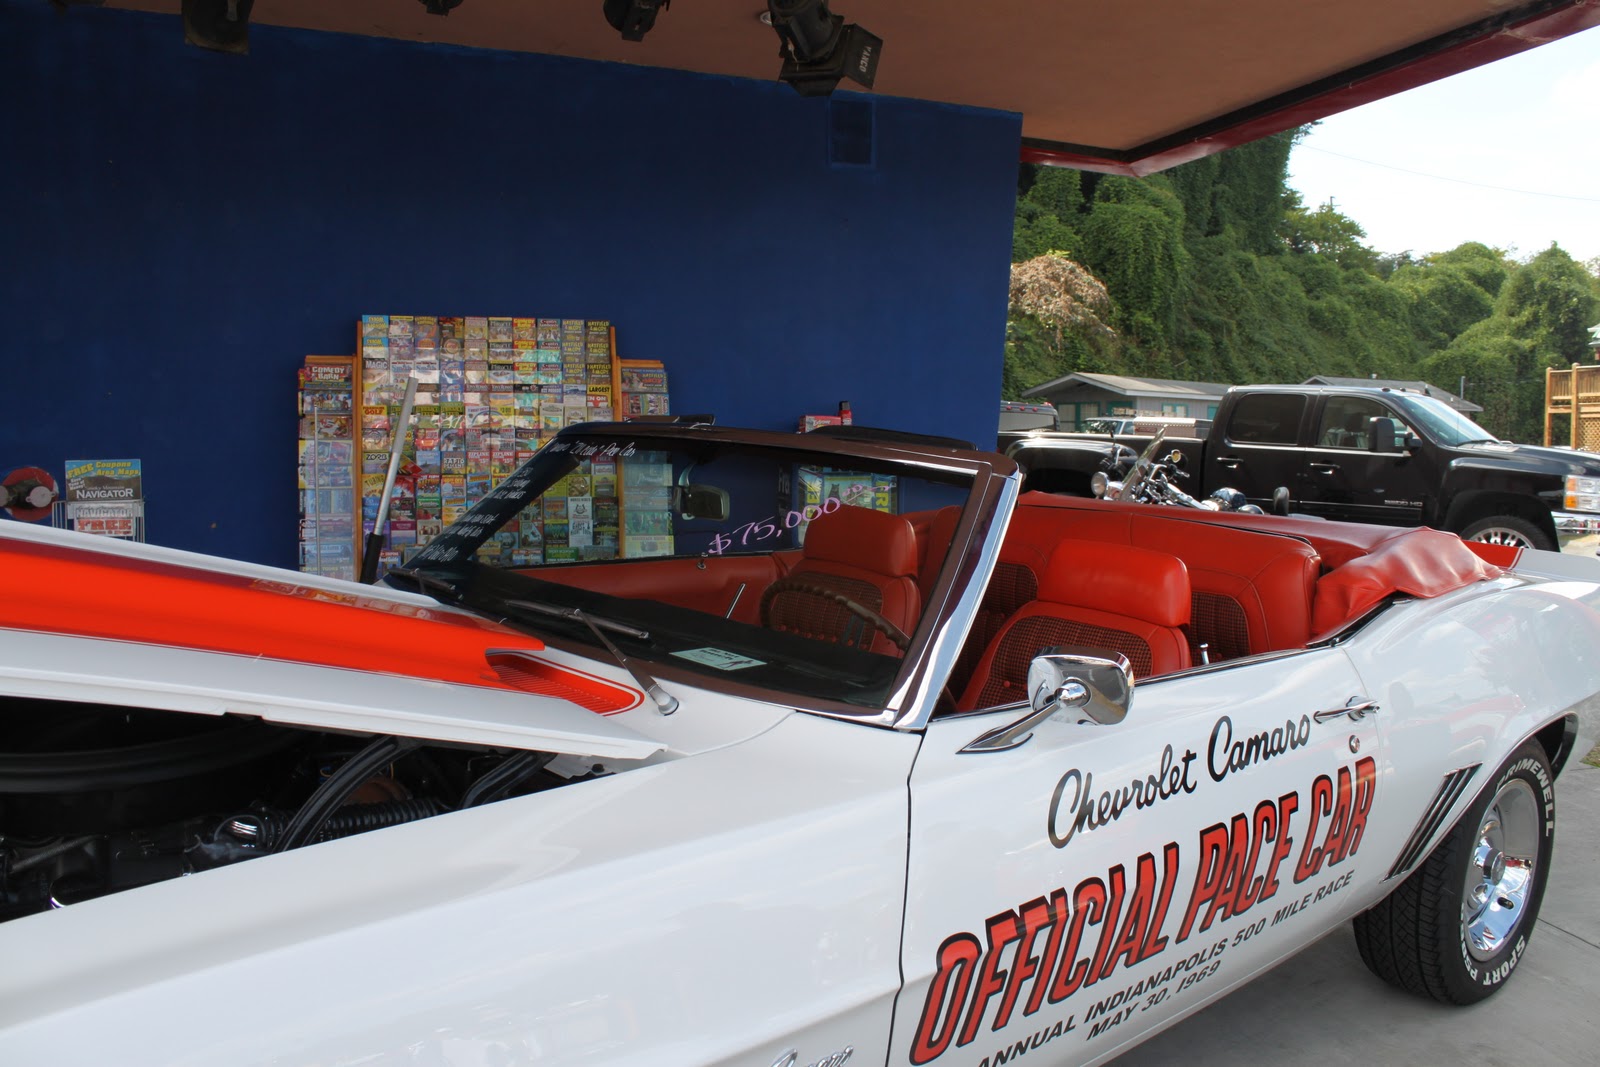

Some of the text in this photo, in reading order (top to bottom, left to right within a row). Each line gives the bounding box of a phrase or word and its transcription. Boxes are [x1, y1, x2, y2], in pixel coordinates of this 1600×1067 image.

[312, 366, 345, 374] COMEDY
[366, 361, 388, 369] MAGIC
[67, 463, 94, 478] FREE
[118, 468, 139, 476] Maps
[76, 488, 134, 499] NAVIGATOR
[78, 519, 132, 531] FREE
[1047, 714, 1310, 848] Chevrolet Camaro
[1495, 758, 1554, 837] PRIMEWELL
[909, 756, 1377, 1066] OFFICIAL PACE CAR
[978, 870, 1355, 1067] ANNUAL INDIANAPOLIS 500 MILE RACE
[1482, 935, 1526, 985] SPORT
[1086, 1009, 1135, 1041] MAY
[1174, 959, 1222, 994] 1969
